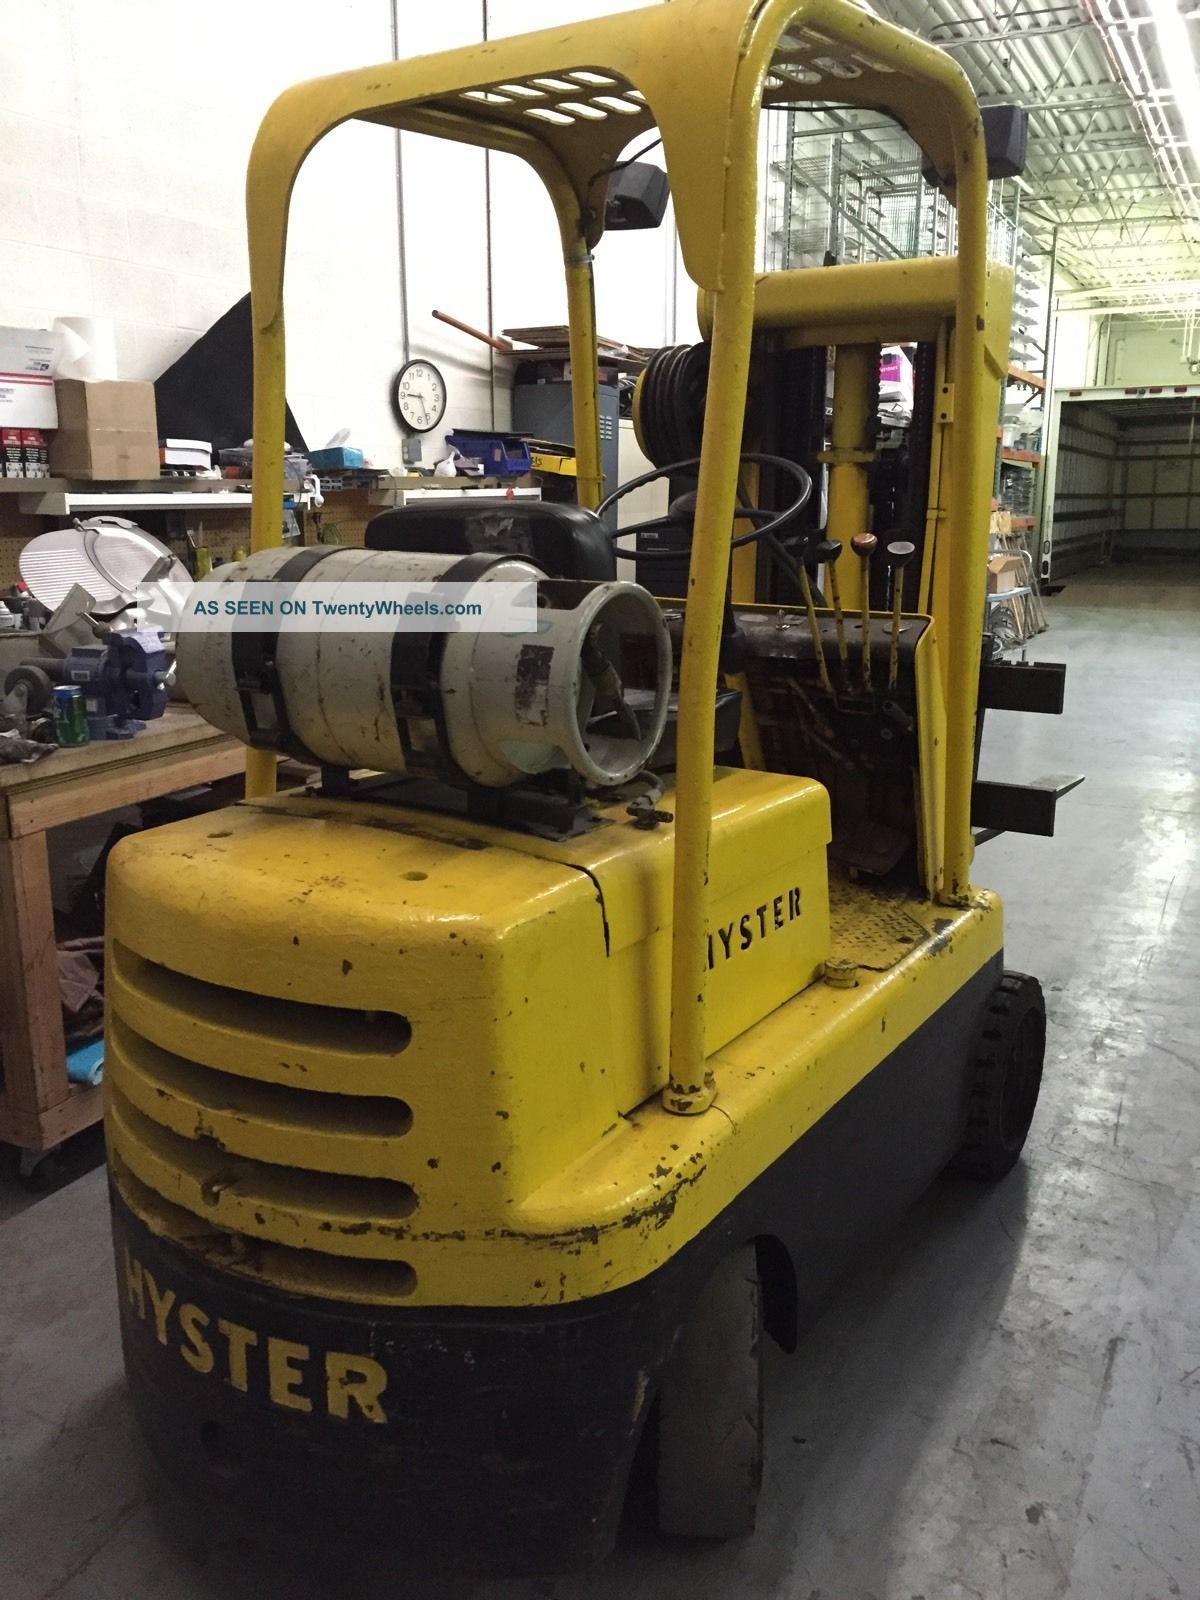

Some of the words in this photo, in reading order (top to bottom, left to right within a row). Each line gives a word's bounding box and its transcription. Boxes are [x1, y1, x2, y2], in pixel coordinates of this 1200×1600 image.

[409, 372, 415, 381] 11
[416, 368, 424, 378] 12
[402, 381, 410, 391] 10
[431, 383, 437, 391] 2
[400, 391, 406, 400] 9
[434, 393, 440, 402] 3
[403, 401, 409, 411] 8
[431, 404, 437, 412] 4
[410, 411, 415, 419] 7
[416, 415, 423, 425] 6
[124, 1245, 388, 1424] HYSTER
